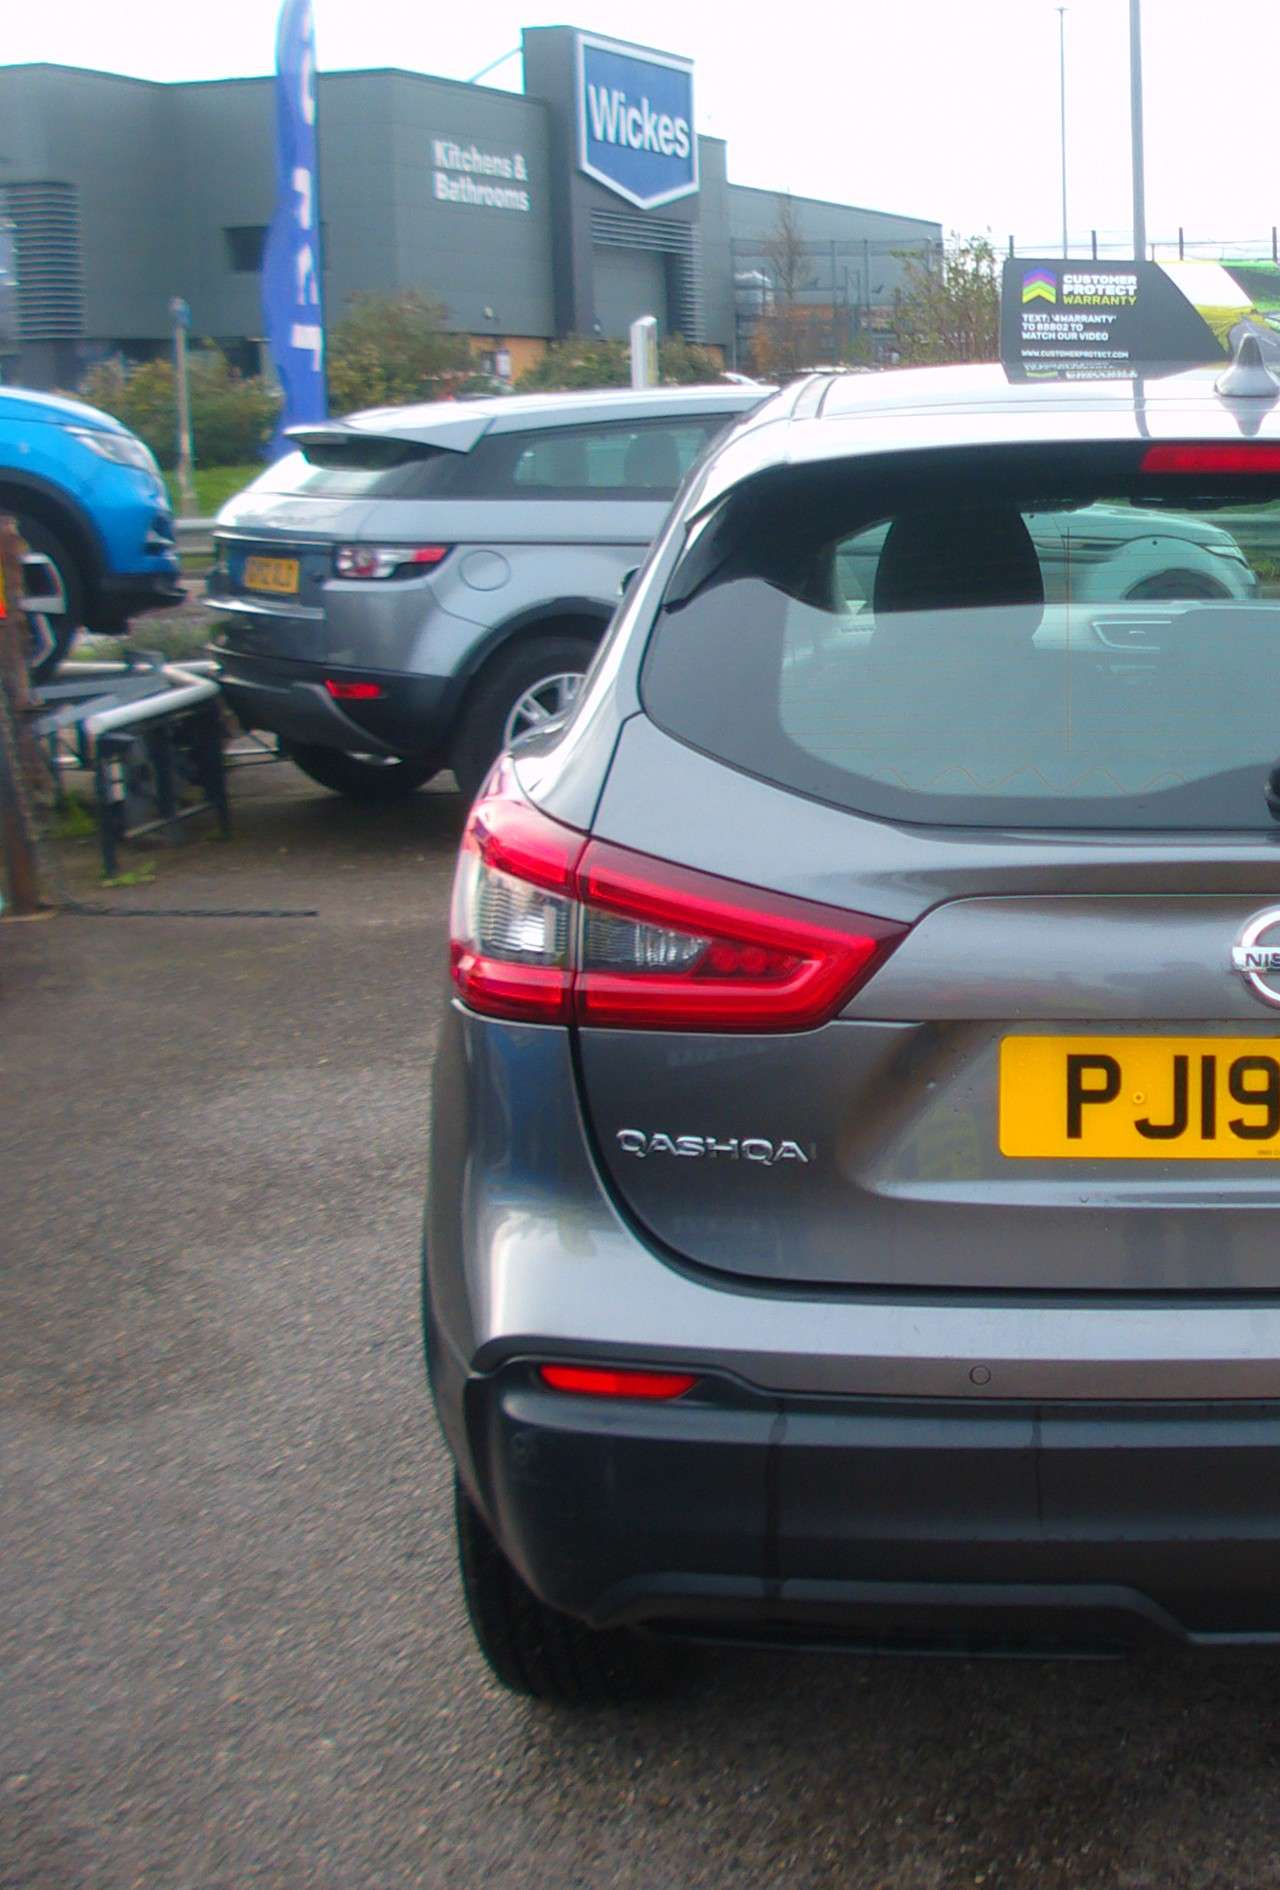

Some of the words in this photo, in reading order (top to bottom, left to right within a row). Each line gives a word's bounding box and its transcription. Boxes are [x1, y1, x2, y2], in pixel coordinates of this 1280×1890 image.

[589, 84, 690, 159] Wickes
[431, 139, 511, 179] Kitchens
[513, 154, 527, 182] &
[432, 170, 530, 211] Bathrooms
[1063, 274, 1137, 284] CUSTOMER
[1063, 284, 1137, 295] PROTECT
[1063, 295, 1137, 305] WARRANTY
[1022, 323, 1035, 331] TO
[1070, 323, 1083, 332] TO
[1022, 331, 1055, 340] WATCH
[1057, 332, 1078, 341] OUR
[1079, 332, 1109, 341] VIDEO
